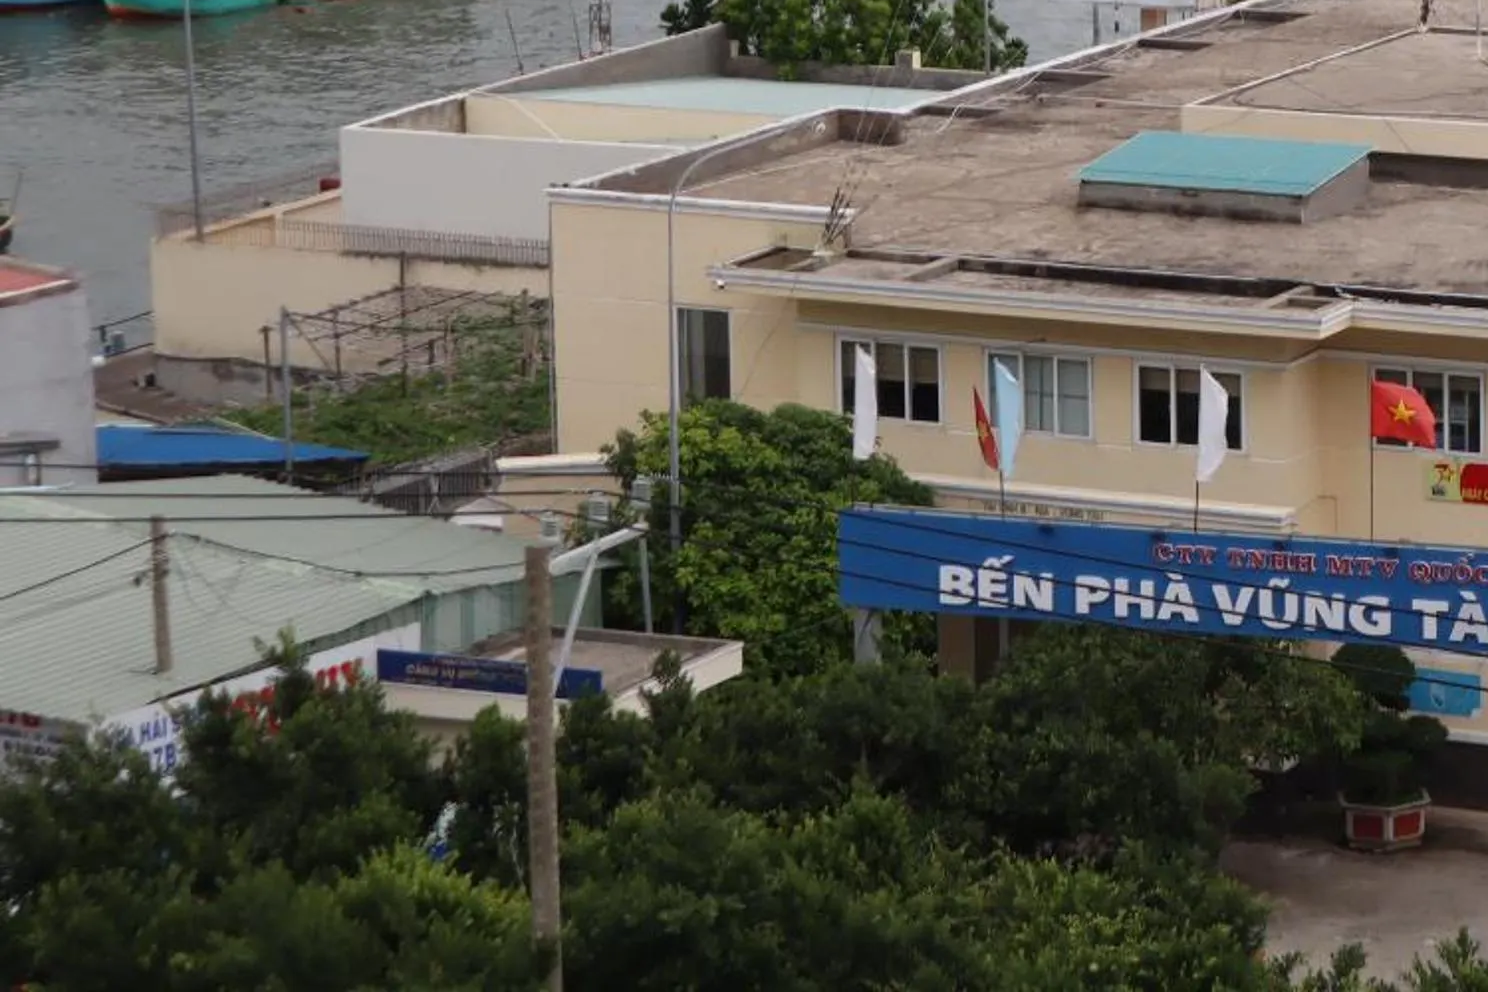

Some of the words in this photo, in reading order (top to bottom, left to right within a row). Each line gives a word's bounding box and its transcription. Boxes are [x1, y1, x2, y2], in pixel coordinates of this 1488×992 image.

[1154, 543, 1217, 565] CTY
[1226, 547, 1317, 574] TNHH
[1326, 554, 1400, 579] MTV
[939, 555, 1053, 612] BẾN
[1074, 572, 1200, 623] PHÀ
[1211, 576, 1392, 637] VŨNG
